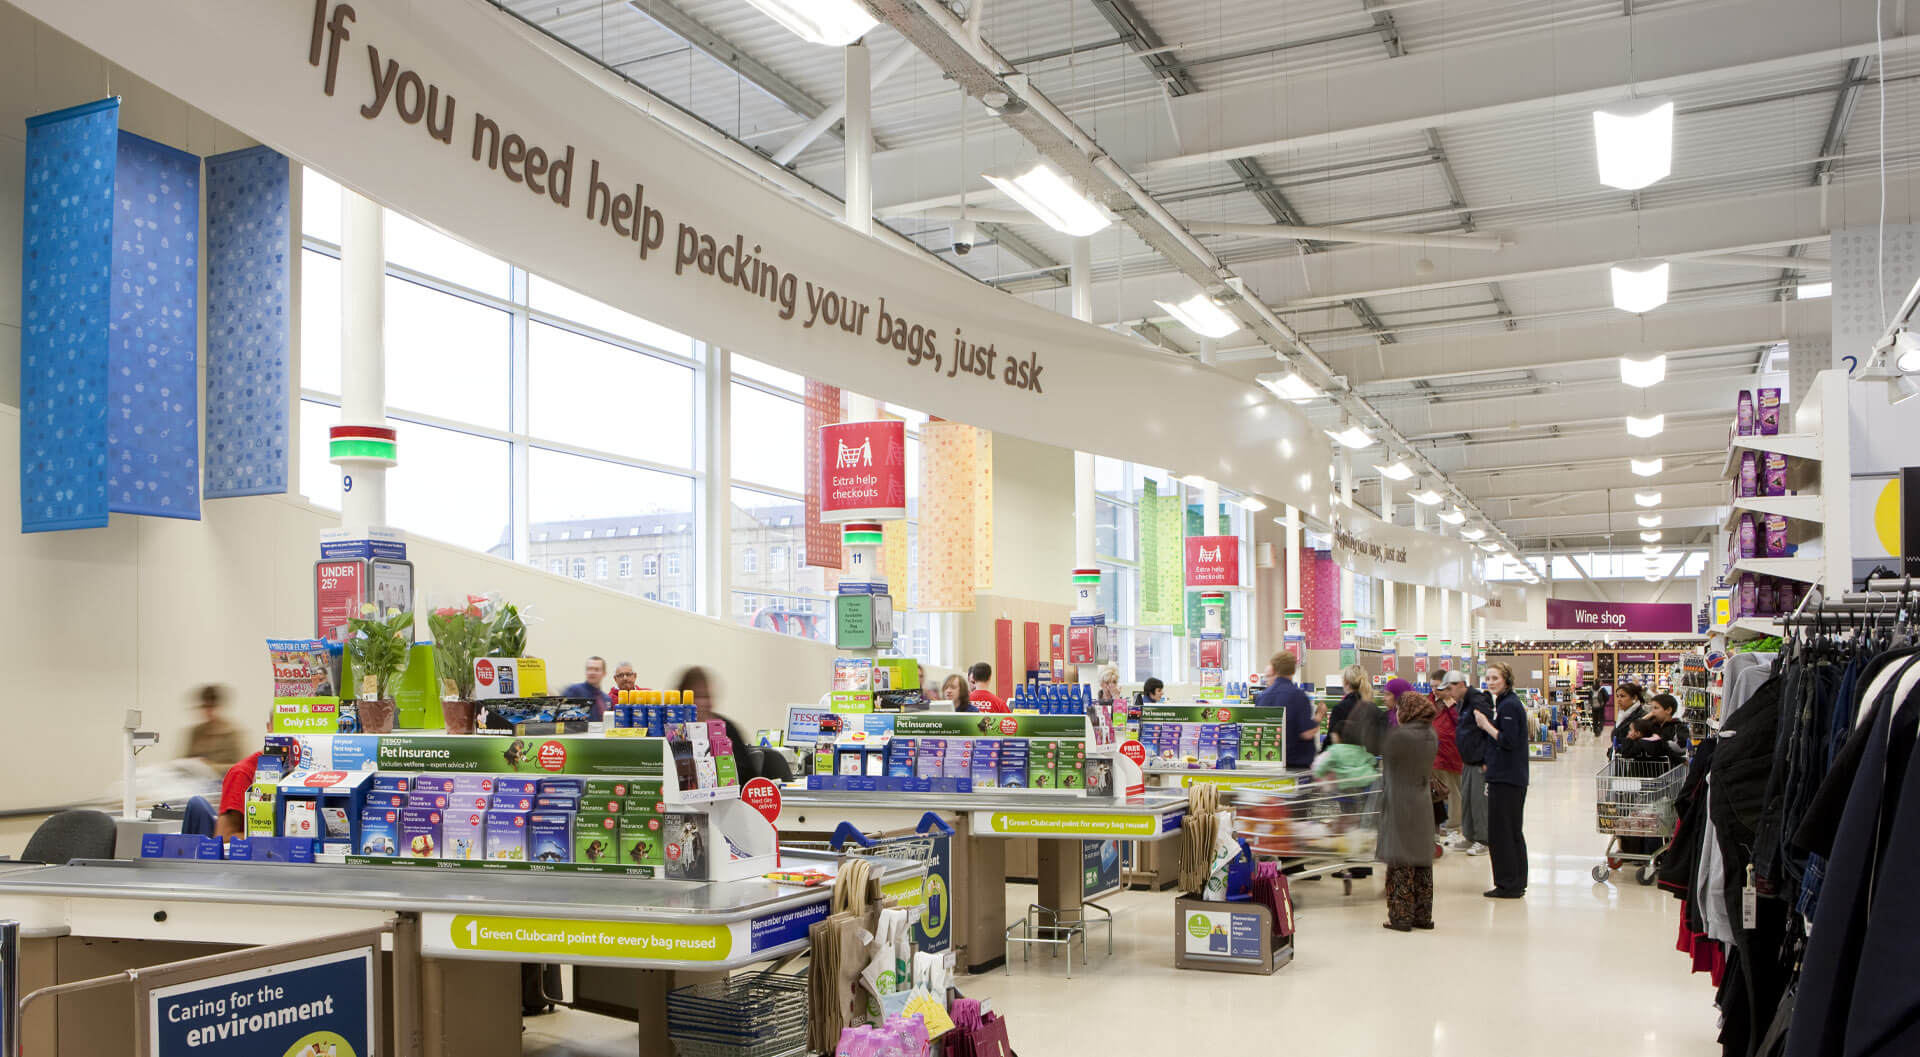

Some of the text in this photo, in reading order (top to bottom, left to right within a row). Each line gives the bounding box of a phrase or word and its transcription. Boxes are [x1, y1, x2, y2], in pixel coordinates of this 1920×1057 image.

[309, 0, 1043, 393] If you need help packing your bags, just ask
[344, 475, 353, 492] 9
[832, 473, 877, 487] Extra help
[832, 487, 879, 499] checkouts
[853, 553, 862, 564] 11
[321, 566, 354, 578] UNDER
[321, 579, 338, 590] 25?
[1080, 590, 1088, 598] 13
[1575, 609, 1626, 627] Wine shop
[273, 663, 311, 679] heat
[478, 671, 493, 679] FREE
[302, 704, 309, 713] &
[313, 705, 335, 713] Closer
[284, 717, 329, 729] Only £1.95
[794, 713, 820, 722] TESC
[909, 721, 942, 729] Insurance
[380, 746, 450, 759] Pet Insurance
[542, 745, 565, 756] 25%
[465, 761, 478, 769] 24/7
[747, 786, 774, 798] FREE
[250, 818, 272, 826] Top-up
[1000, 816, 1008, 829] 1
[1009, 818, 1028, 826] Green
[1030, 818, 1059, 827] Clubcard
[1080, 819, 1089, 828] for
[1111, 820, 1124, 830] bag
[752, 904, 827, 930] Remember your reusable bags
[465, 920, 716, 950] 1 Green Clubcard point for every bag reused
[168, 985, 284, 1023] Caring for the
[186, 994, 334, 1047] environment
